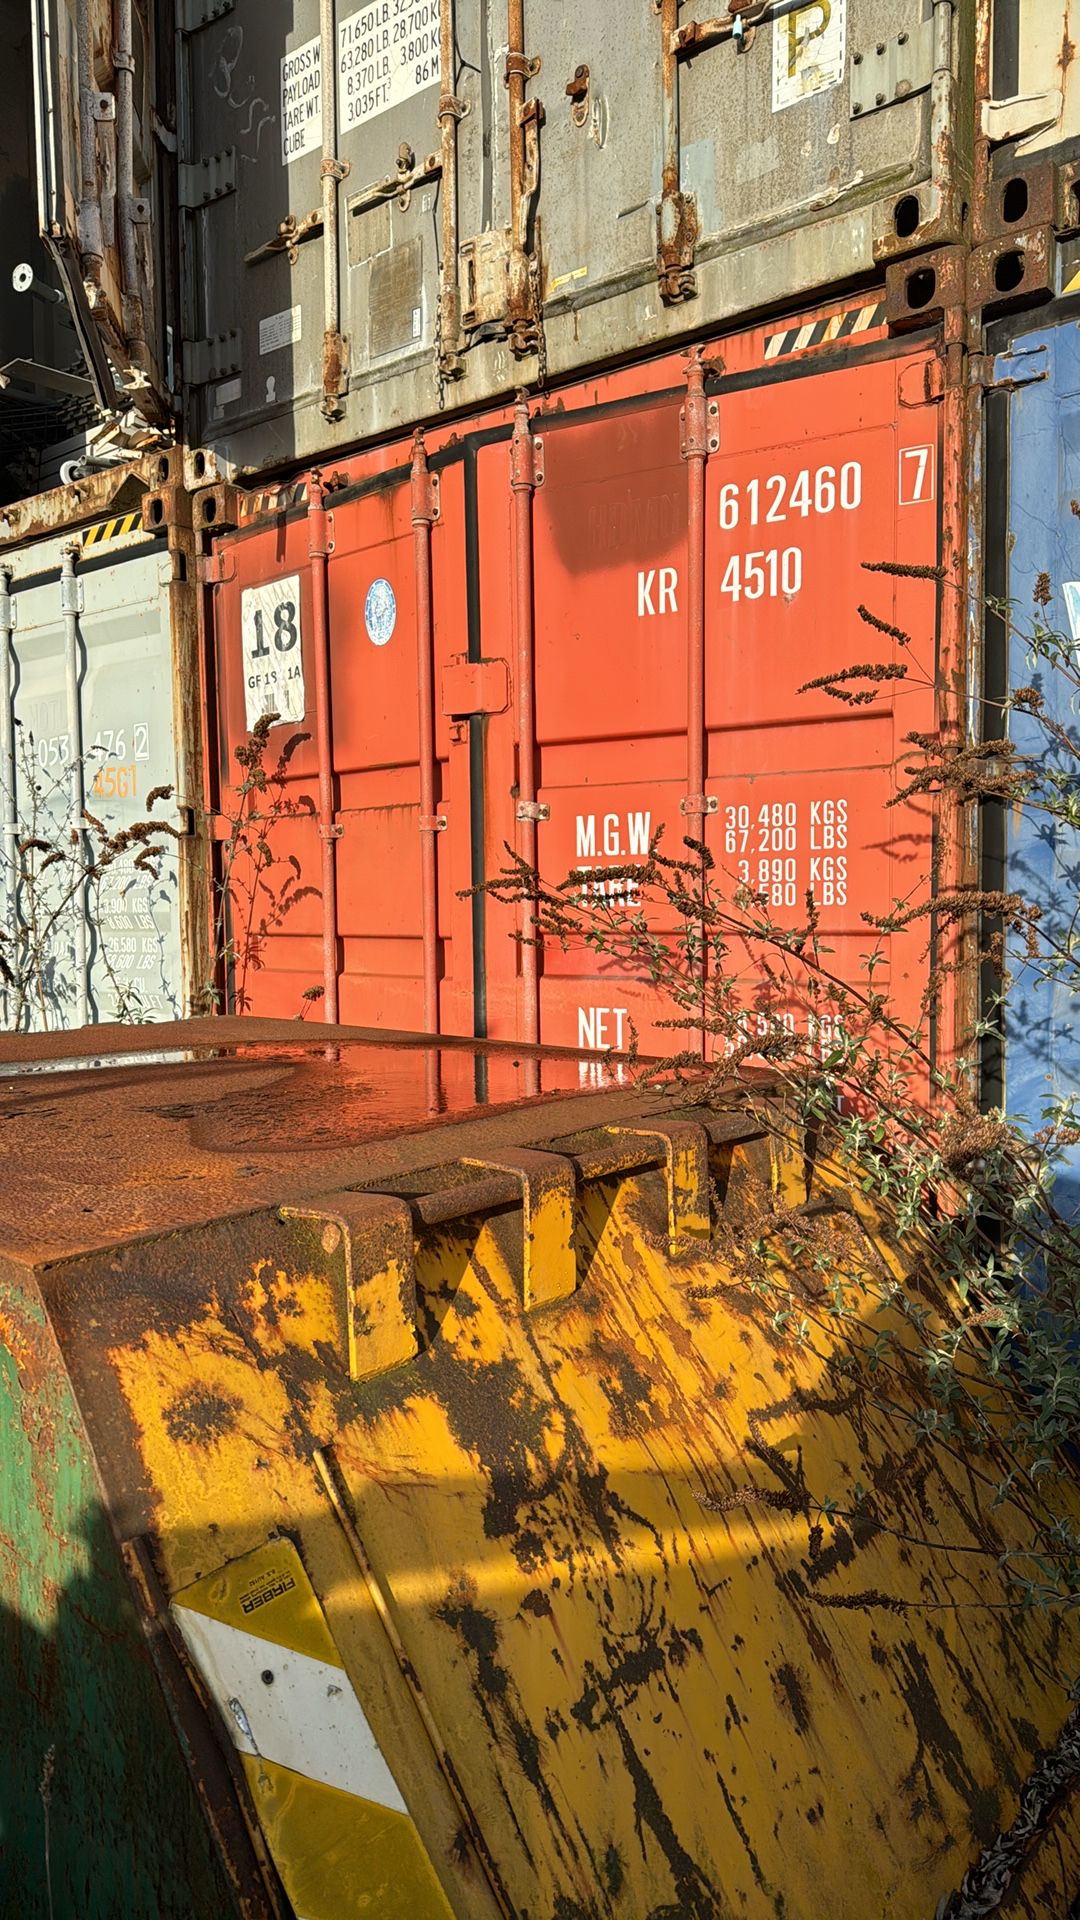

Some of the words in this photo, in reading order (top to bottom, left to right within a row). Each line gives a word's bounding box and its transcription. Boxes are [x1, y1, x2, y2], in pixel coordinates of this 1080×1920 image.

[282, 49, 311, 82] GROSS
[340, 12, 374, 48] 71,650
[282, 70, 320, 108] PAYLOAD
[341, 38, 374, 74] 63,280
[393, 6, 428, 44] 28,700
[431, 0, 441, 22] K
[283, 104, 305, 131] TARE
[347, 65, 374, 96] 8,370
[400, 33, 428, 67] 3,800
[431, 27, 441, 50] K
[284, 128, 305, 156] CUBE
[348, 91, 374, 122] 3,035
[415, 60, 429, 85] 86
[719, 461, 861, 530] 612460
[905, 448, 929, 500] 7
[637, 567, 678, 617] KR
[721, 546, 802, 602] 4510
[251, 601, 298, 659] 18
[39, 735, 69, 767] 053
[135, 726, 147, 757] 2
[576, 811, 651, 857] M.G.W
[725, 803, 797, 830] 30,480
[810, 799, 848, 825] KGS
[725, 827, 797, 855] 67,200
[810, 824, 848, 850] LBS
[738, 858, 797, 884] 3,890
[810, 857, 848, 881] KGS
[132, 898, 148, 913] KGS
[810, 881, 848, 906] LBS
[142, 936, 158, 953] KGS
[578, 1007, 627, 1050] NET
